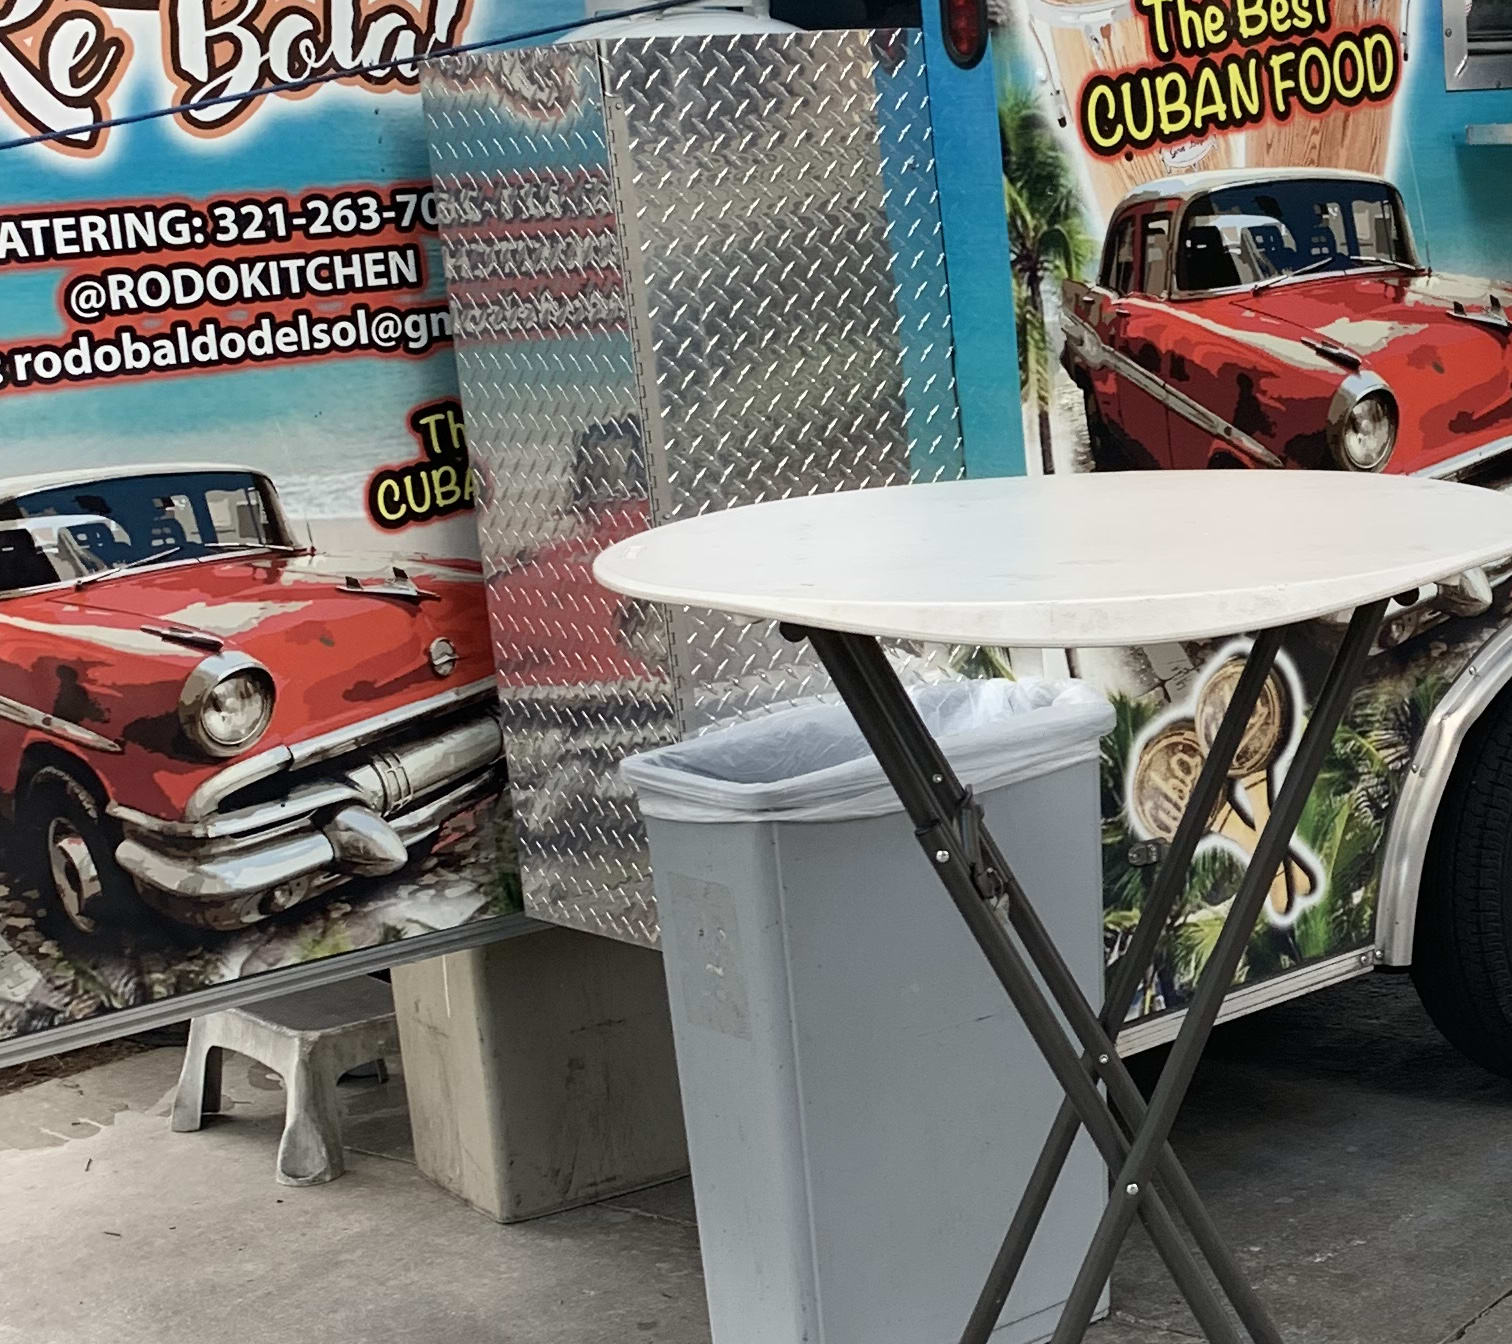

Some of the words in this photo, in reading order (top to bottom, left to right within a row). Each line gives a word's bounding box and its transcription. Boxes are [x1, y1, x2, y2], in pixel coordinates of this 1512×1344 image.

[1087, 56, 1258, 148] CUBAN
[1269, 33, 1395, 113] FOOD
[0, 207, 204, 258] ATERING:
[215, 193, 438, 242] 321-263-70
[70, 250, 418, 318] @RODOKITCHEN
[419, 411, 465, 454] Th
[377, 465, 476, 521] CUBA
